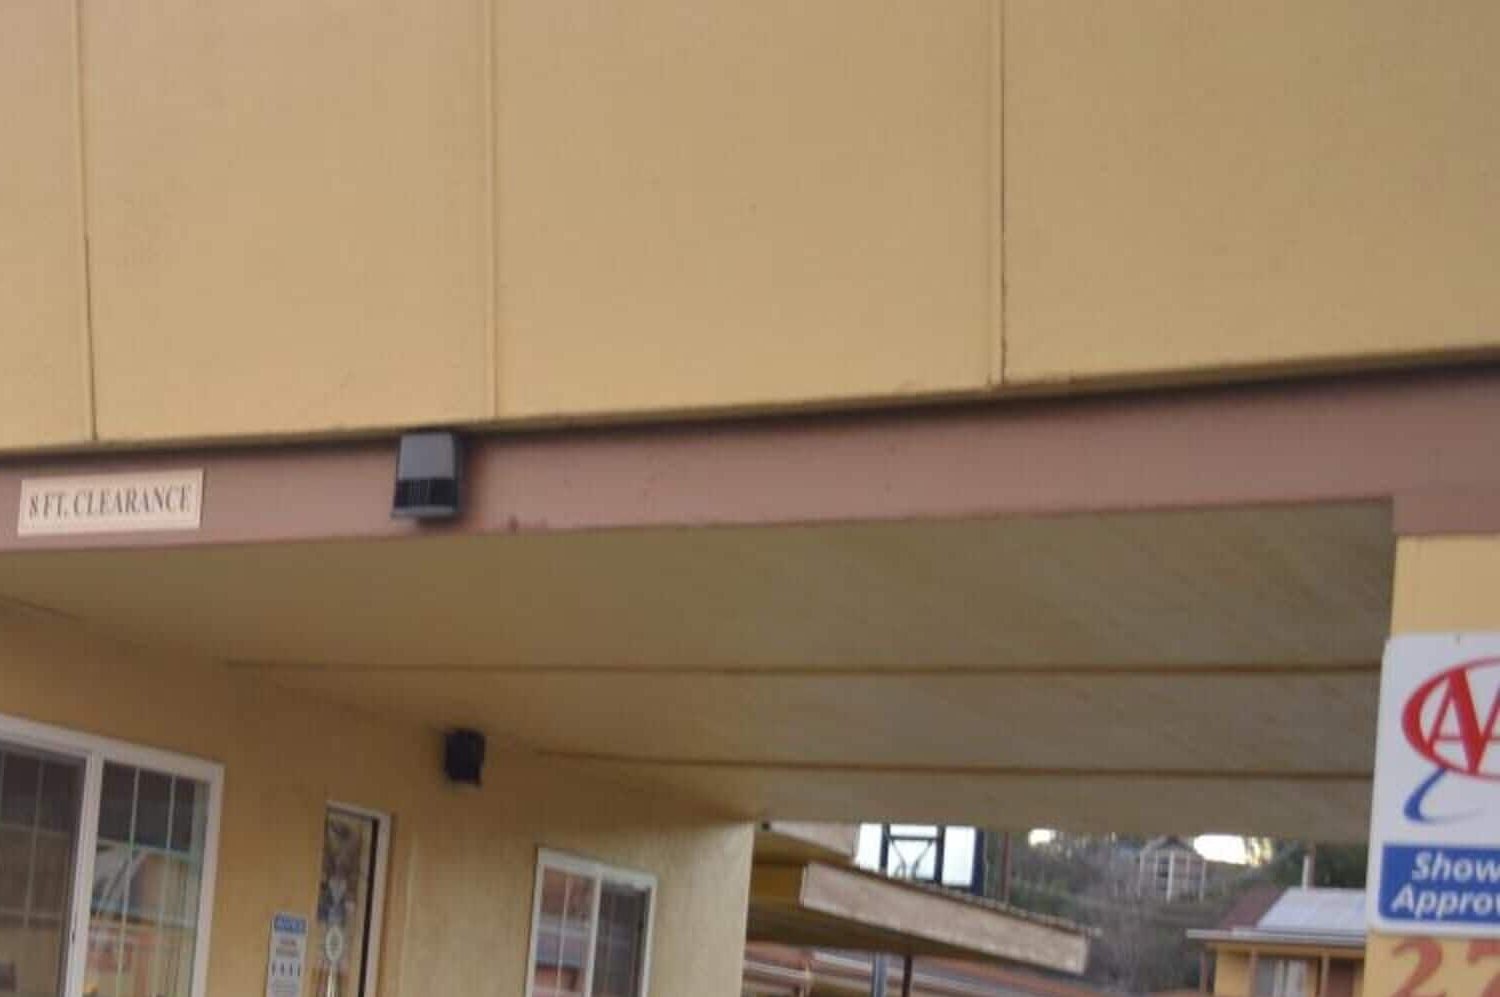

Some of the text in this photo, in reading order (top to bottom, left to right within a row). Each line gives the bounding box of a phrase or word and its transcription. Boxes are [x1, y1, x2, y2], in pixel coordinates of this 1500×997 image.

[28, 484, 193, 520] 8 FT. CLEARANCE
[1411, 851, 1500, 882] Show
